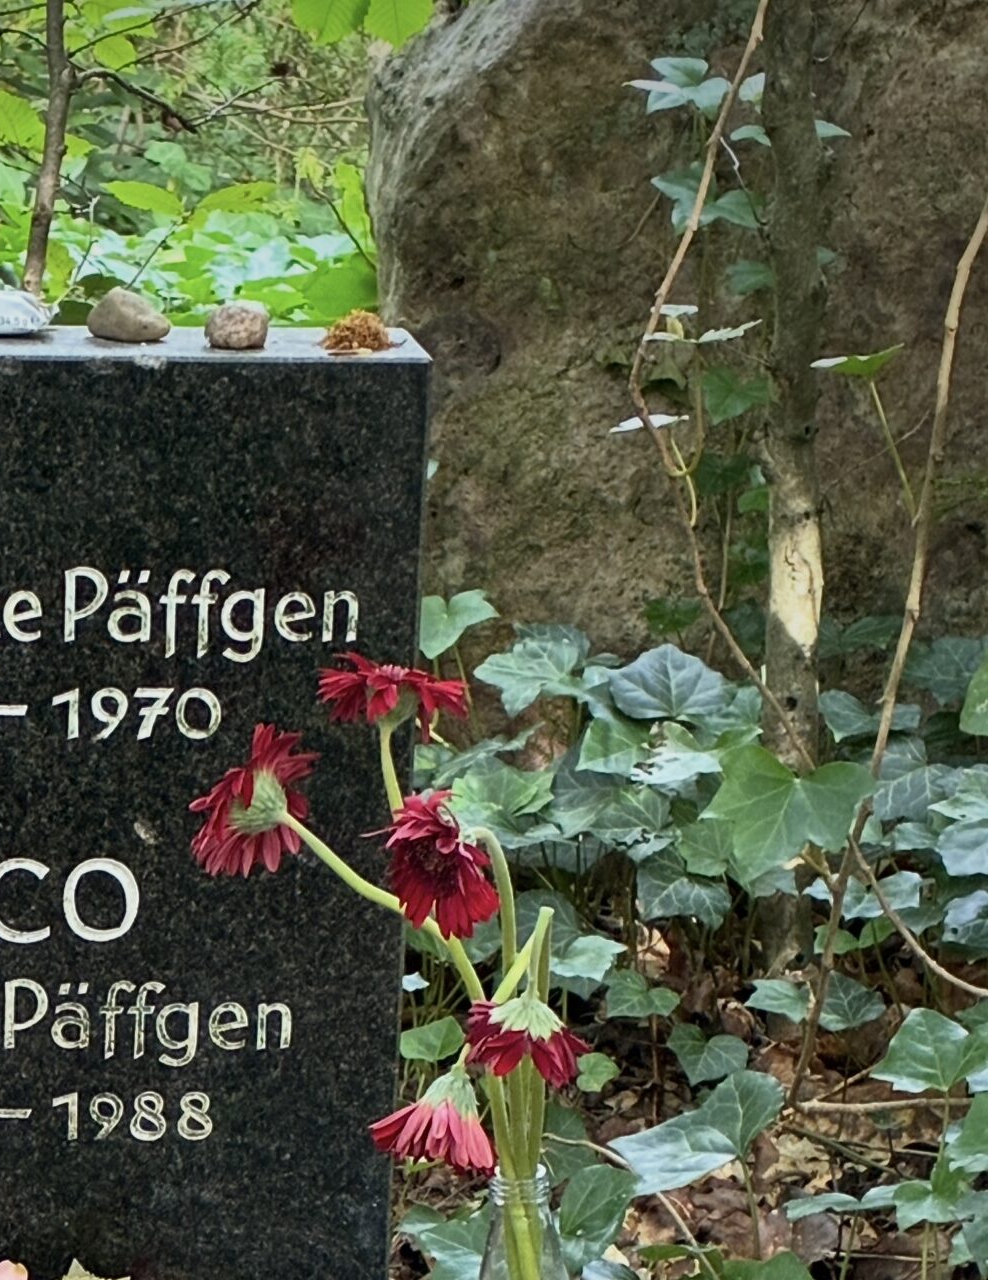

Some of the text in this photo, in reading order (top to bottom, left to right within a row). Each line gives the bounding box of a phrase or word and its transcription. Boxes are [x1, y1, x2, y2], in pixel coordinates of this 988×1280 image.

[63, 566, 359, 663] Päffgen
[51, 687, 222, 741] 1970
[3, 978, 293, 1067] Päffgen
[52, 1091, 214, 1142] 1988
